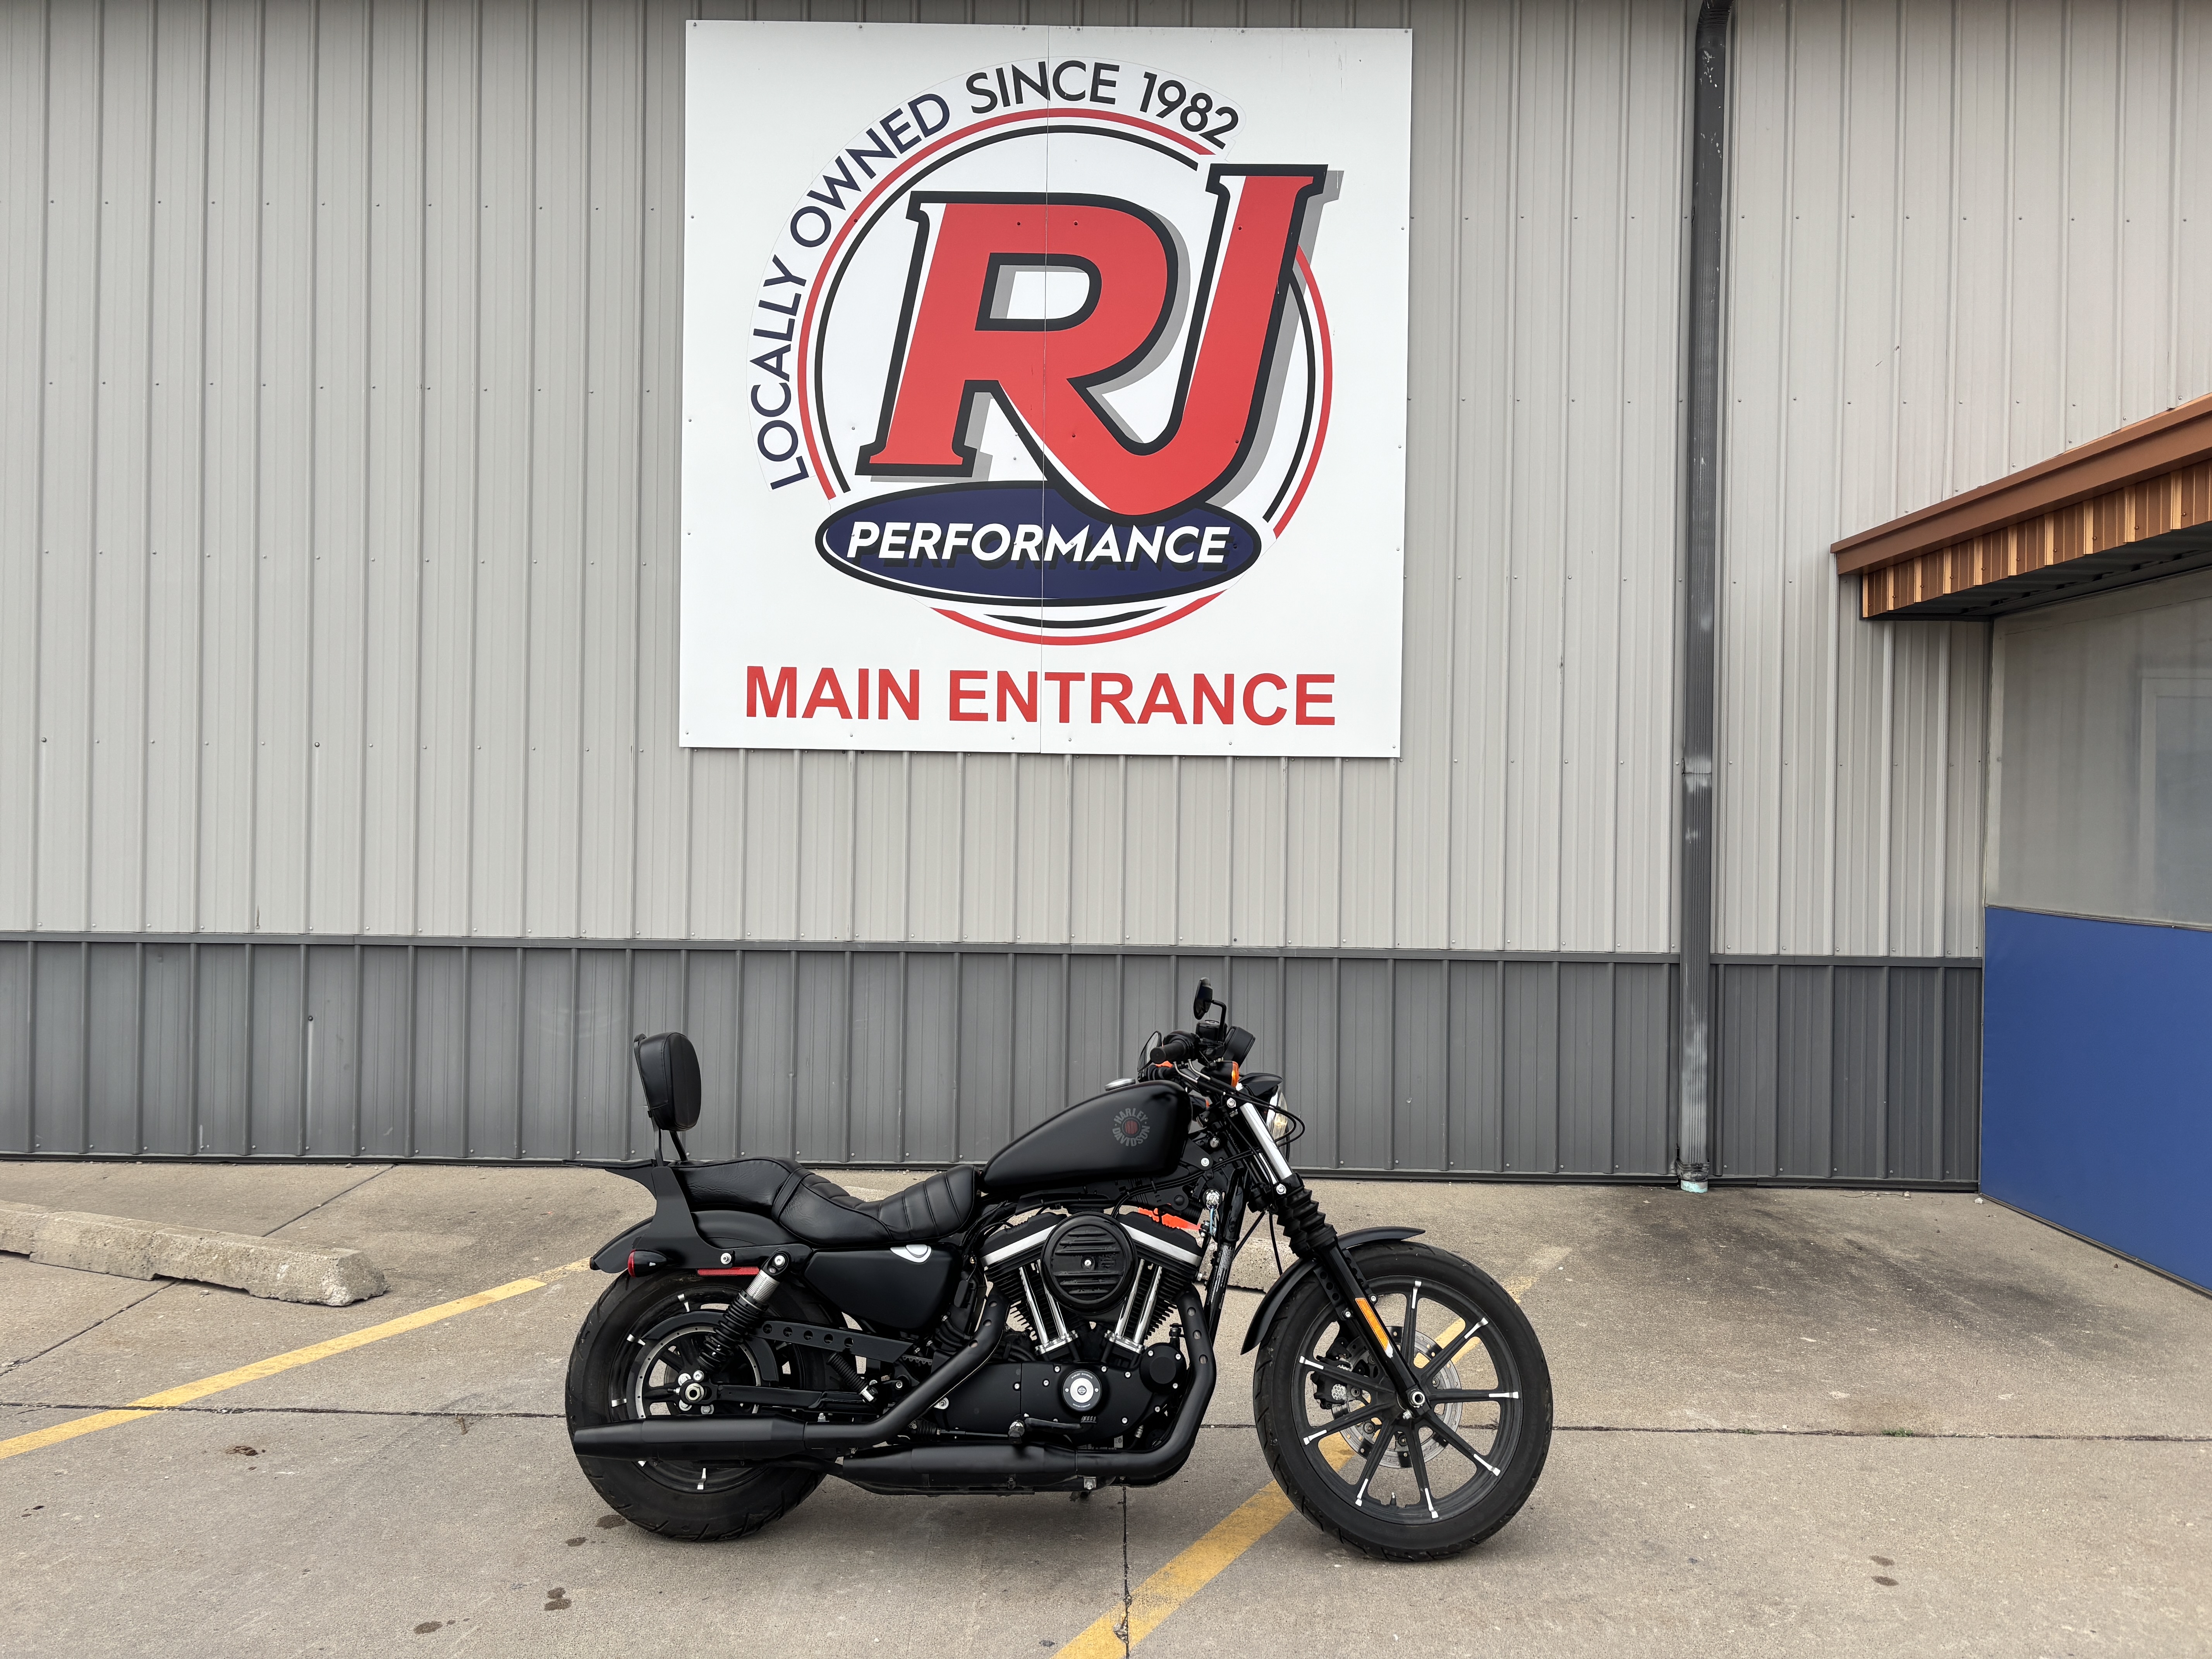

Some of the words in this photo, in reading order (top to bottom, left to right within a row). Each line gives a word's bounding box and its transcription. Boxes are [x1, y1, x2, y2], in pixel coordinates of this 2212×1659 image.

[749, 254, 809, 490] LOCALLY
[790, 93, 950, 247] OWNED
[966, 60, 1120, 114] SINCE
[1140, 71, 1238, 149] 1982
[855, 163, 1328, 525] RJ
[847, 521, 1230, 563] PERFORMANCE
[747, 666, 920, 720] MAIN
[950, 670, 1335, 726] ENTRANCE
[1112, 1125, 1150, 1147] DAVIDSON
[1113, 1108, 1148, 1124] HARLEY
